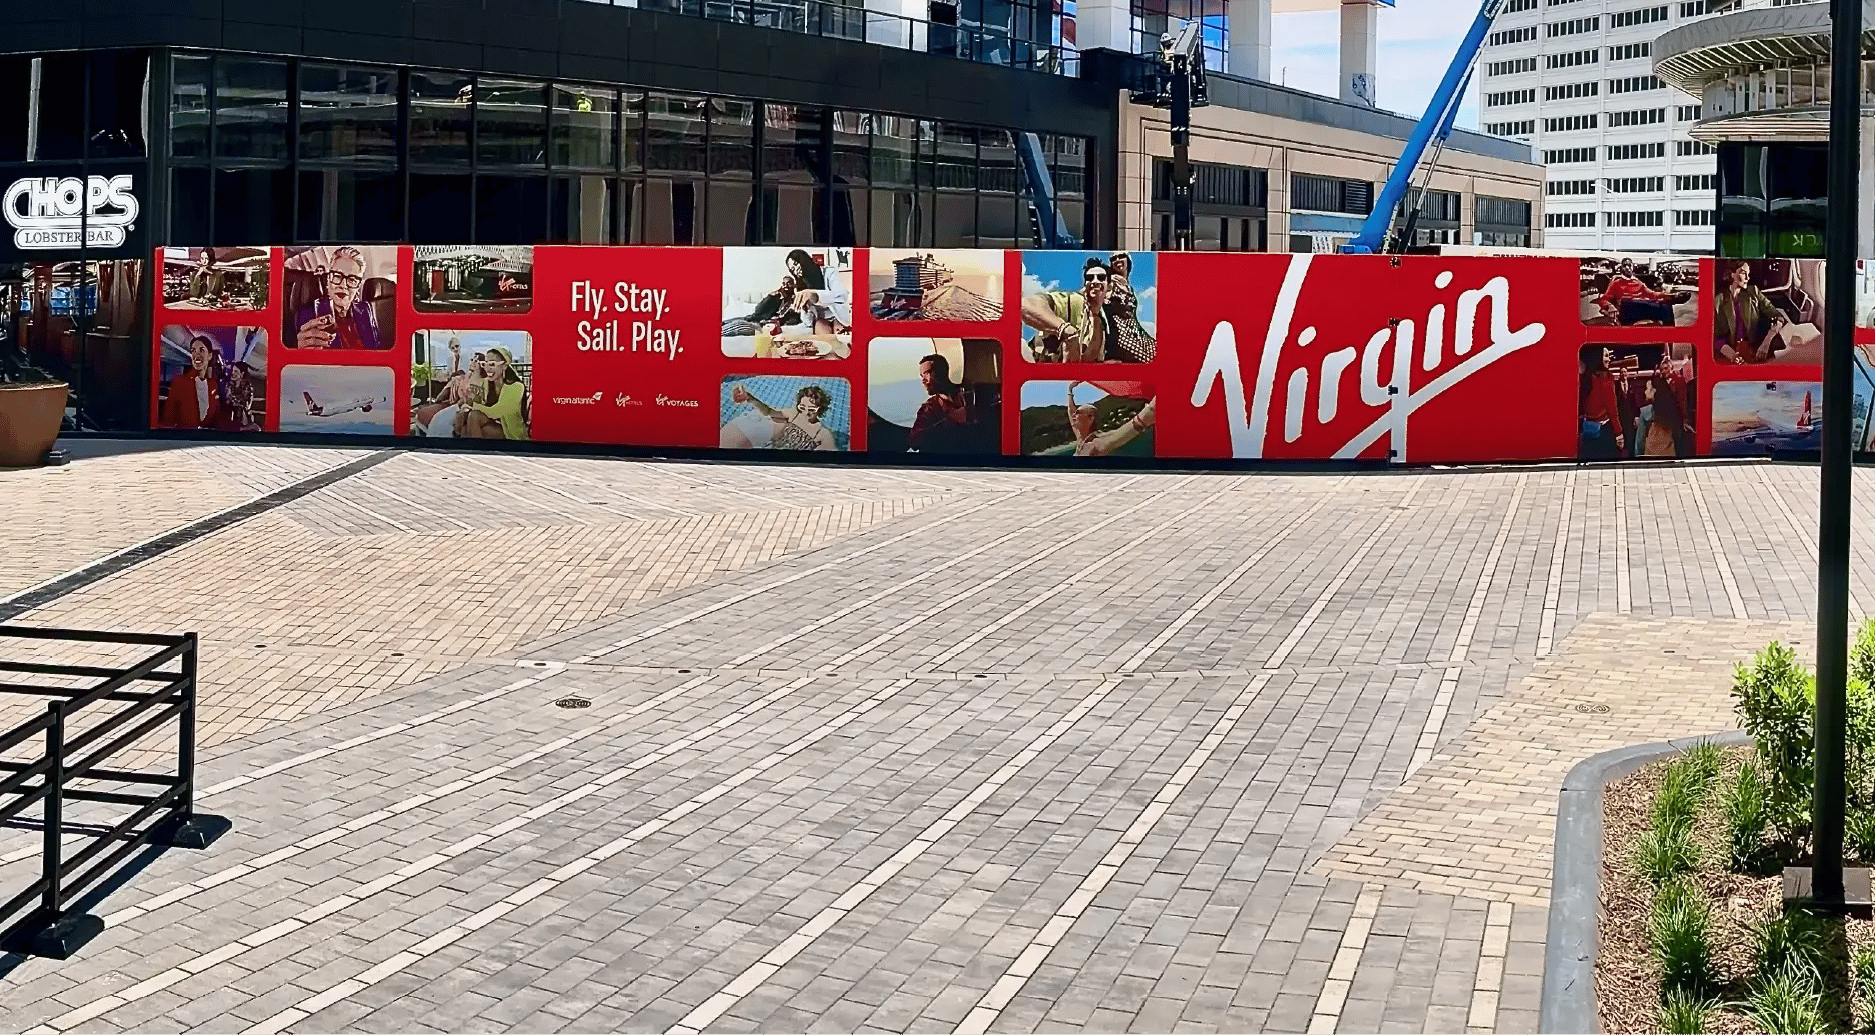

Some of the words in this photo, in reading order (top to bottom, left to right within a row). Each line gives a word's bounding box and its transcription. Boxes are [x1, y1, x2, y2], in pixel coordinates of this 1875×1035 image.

[2, 174, 139, 228] CHOPS
[25, 232, 82, 244] LOBSTER
[86, 231, 114, 242] BAR
[571, 280, 608, 320] Fly.
[614, 281, 670, 320] Stay.
[577, 320, 625, 351] Sail.
[632, 320, 684, 361] Play.
[1191, 254, 1546, 463] Virgin
[666, 399, 699, 407] VOYAGES
